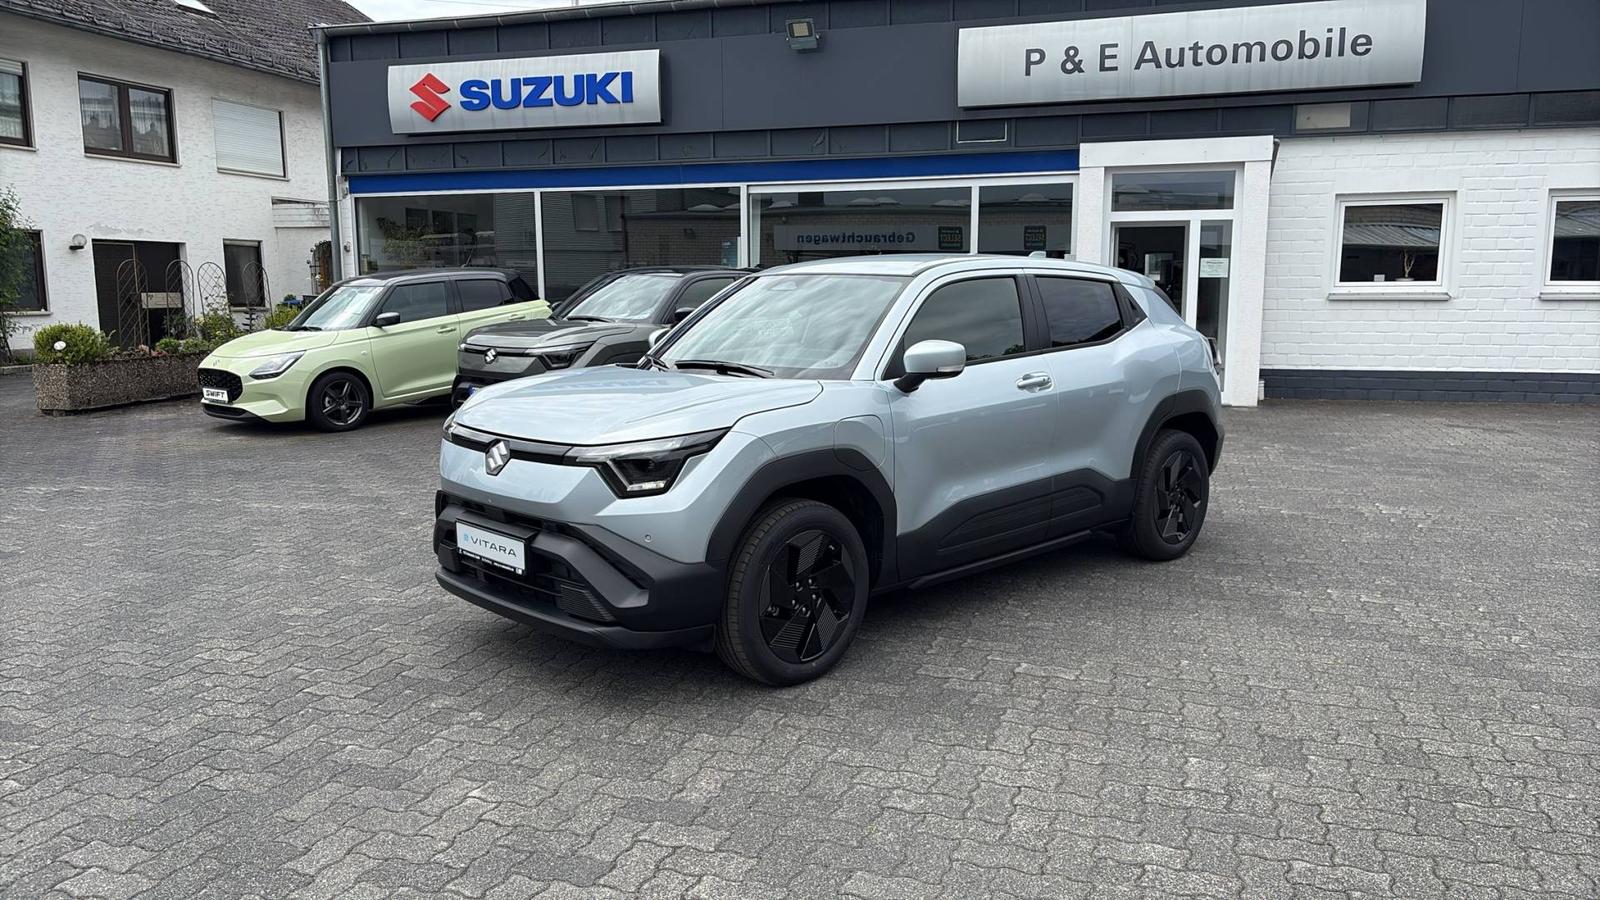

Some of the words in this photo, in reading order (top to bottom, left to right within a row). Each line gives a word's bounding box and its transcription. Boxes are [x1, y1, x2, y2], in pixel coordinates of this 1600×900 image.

[1024, 48, 1046, 76] P
[1060, 45, 1085, 74] &
[1100, 43, 1119, 72] E
[1134, 27, 1373, 70] Automobile
[459, 71, 633, 111] SUZUKI
[205, 390, 225, 398] SWIFT
[471, 536, 517, 557] VITARA
